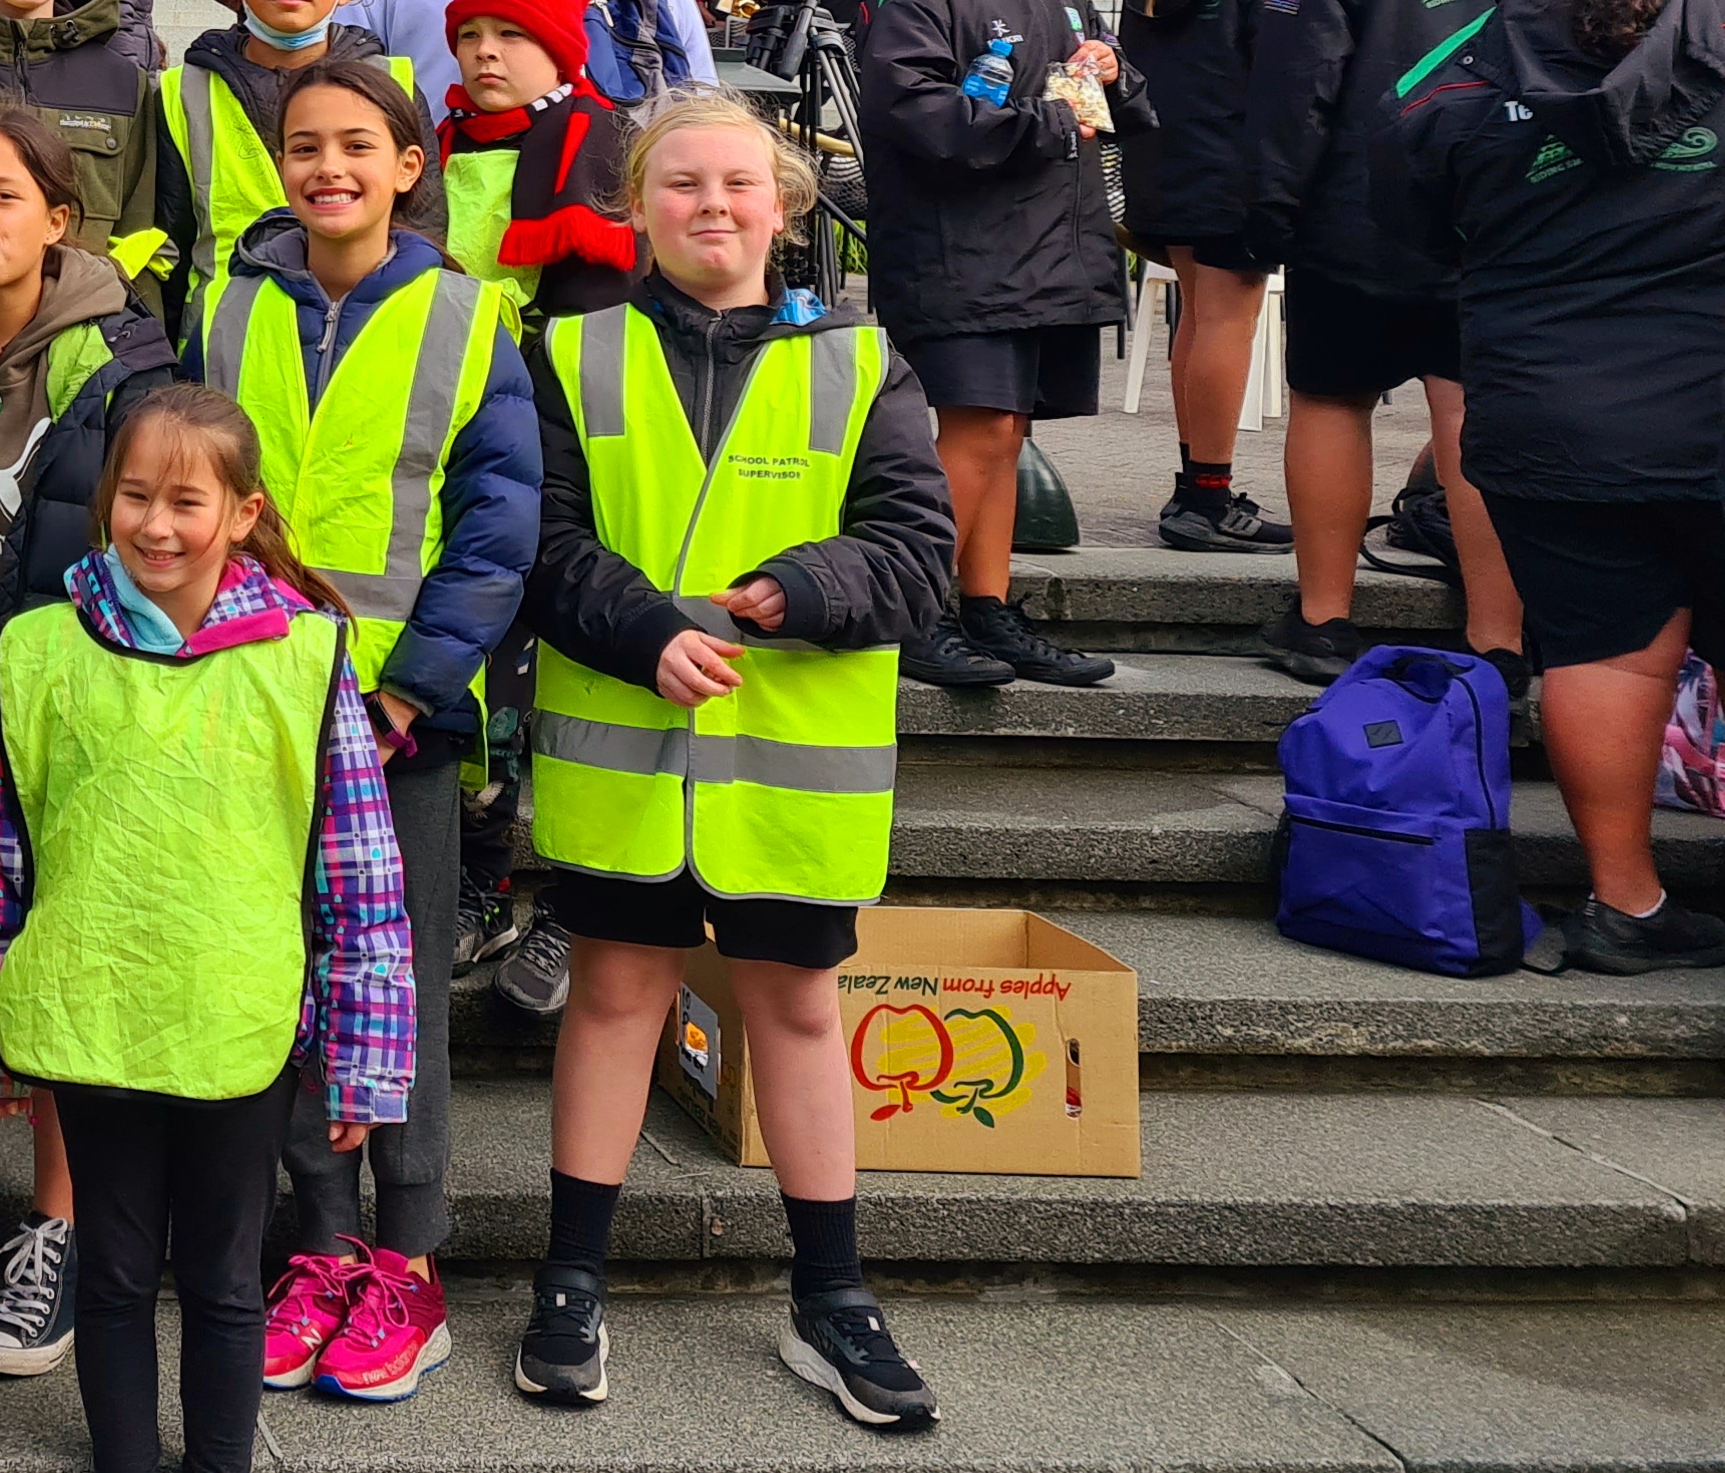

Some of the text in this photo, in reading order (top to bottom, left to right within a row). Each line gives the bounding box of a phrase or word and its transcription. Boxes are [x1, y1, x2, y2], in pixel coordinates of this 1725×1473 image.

[728, 455, 810, 467] SCHOOL PATROL
[739, 469, 801, 479] SUPERVISOR
[838, 973, 1072, 1002] Apples from New Zeala
